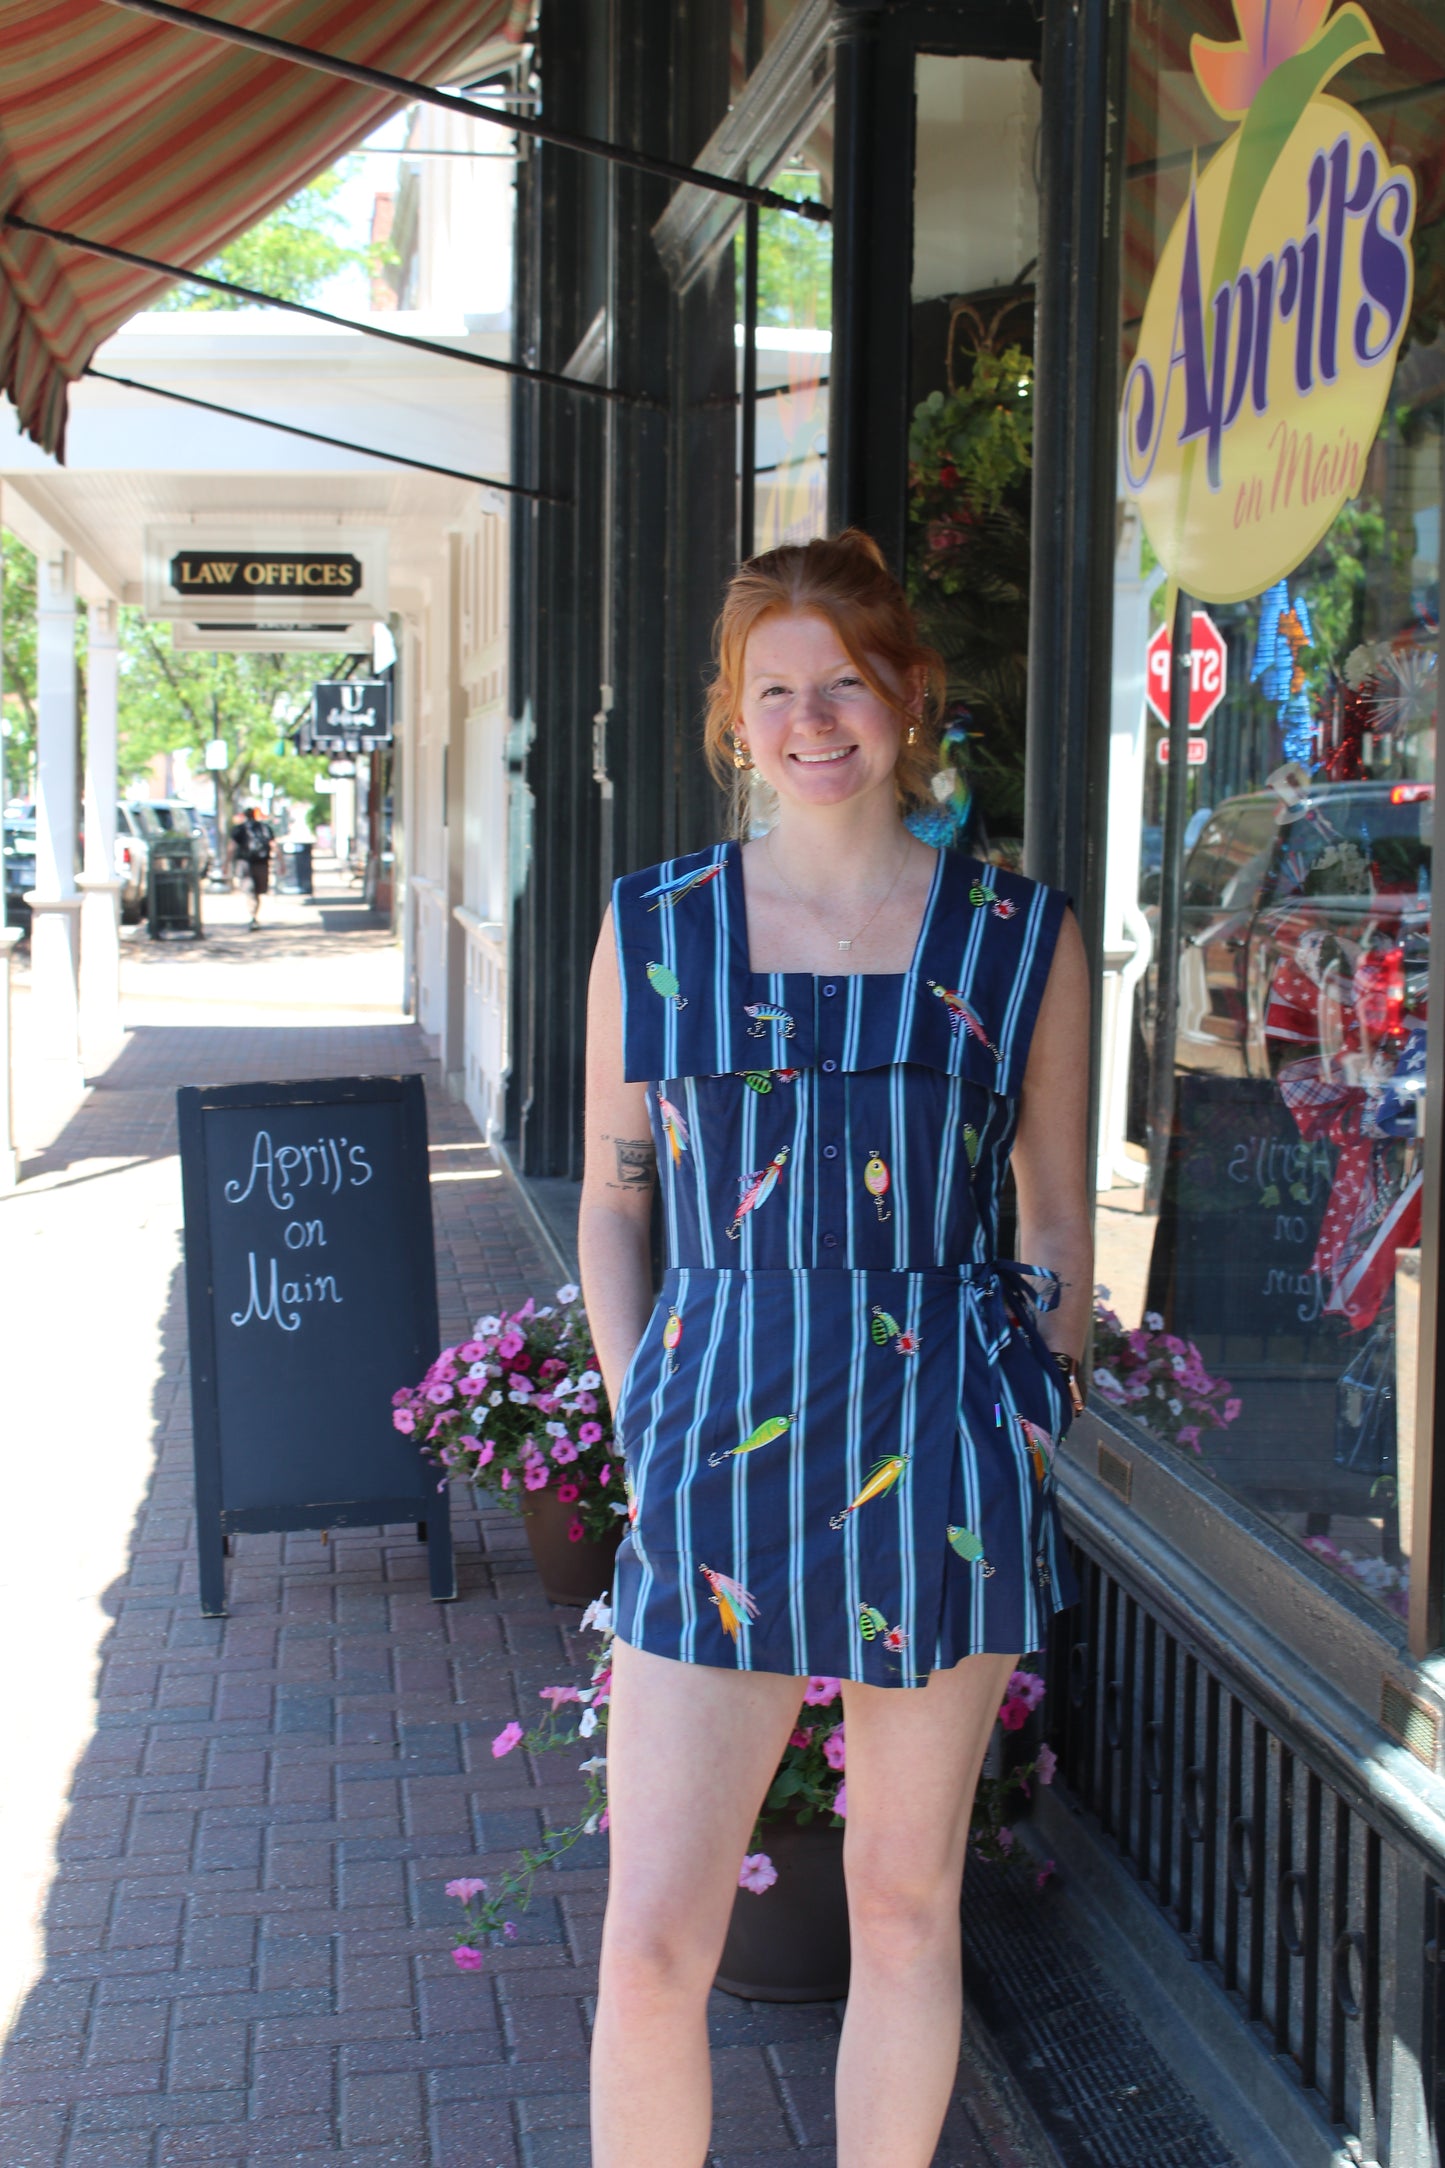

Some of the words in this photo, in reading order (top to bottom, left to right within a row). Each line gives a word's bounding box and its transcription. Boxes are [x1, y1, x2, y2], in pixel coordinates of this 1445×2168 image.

[1122, 130, 1411, 492] April's
[1233, 474, 1263, 530] on
[1267, 419, 1359, 514] Main
[181, 561, 239, 585] LAW
[243, 562, 353, 586] OFFICES
[224, 1130, 373, 1210] April's
[284, 1219, 327, 1249] on
[230, 1252, 343, 1331] Main
